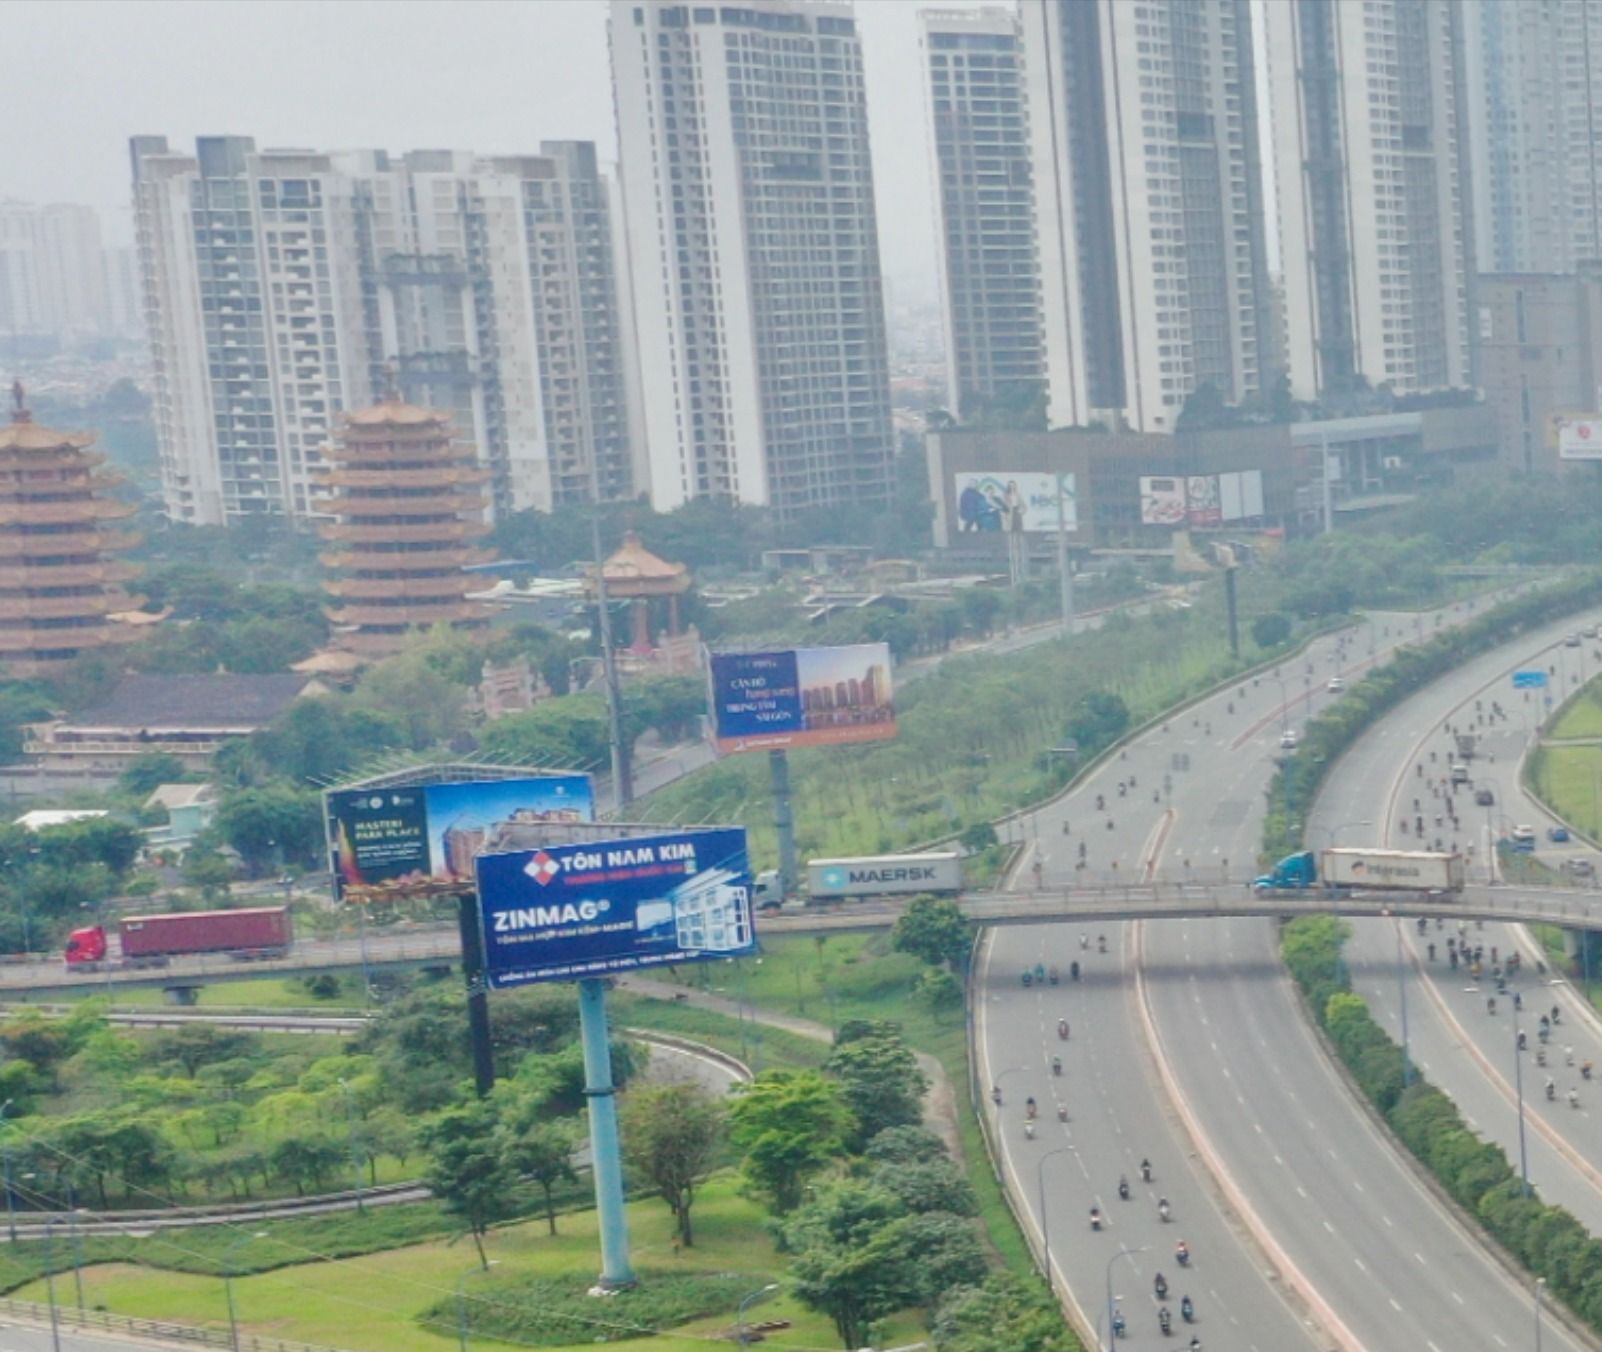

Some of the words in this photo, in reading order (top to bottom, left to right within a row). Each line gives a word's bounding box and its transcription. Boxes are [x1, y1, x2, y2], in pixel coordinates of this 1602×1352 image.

[561, 851, 602, 872] TÔN
[607, 846, 654, 867] NAM
[659, 842, 696, 860] KIM
[849, 866, 937, 884] MAERSK
